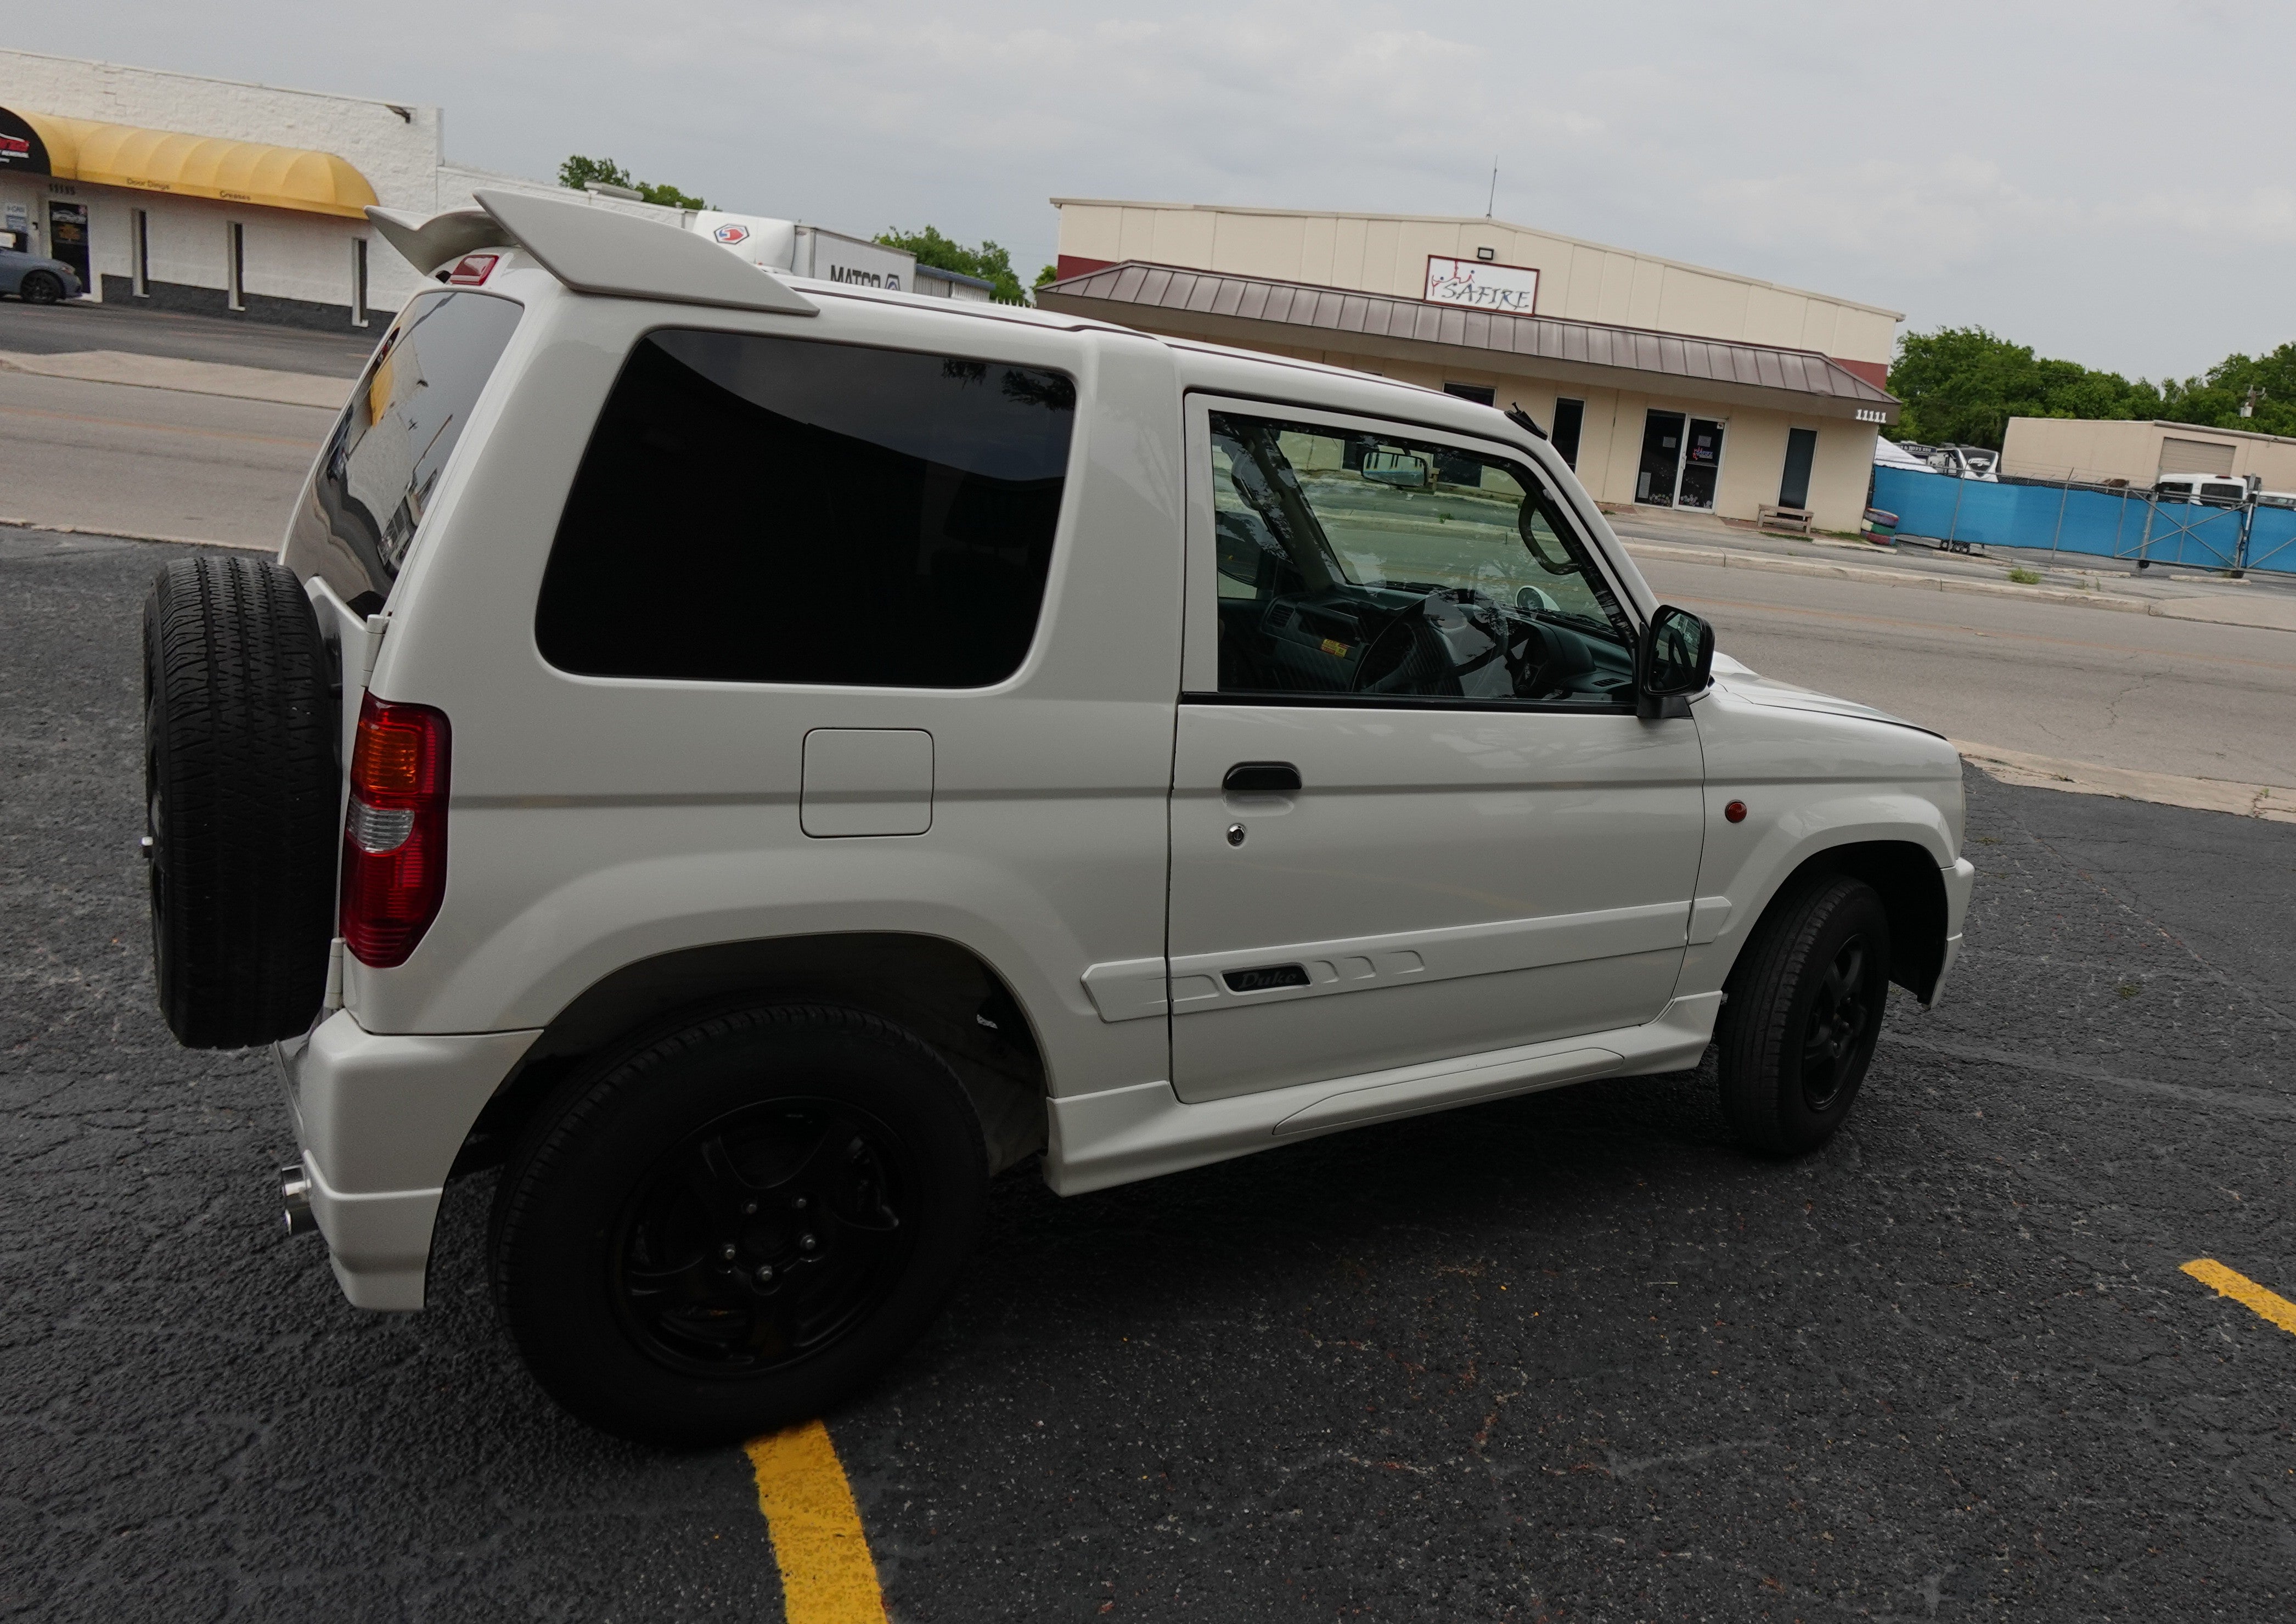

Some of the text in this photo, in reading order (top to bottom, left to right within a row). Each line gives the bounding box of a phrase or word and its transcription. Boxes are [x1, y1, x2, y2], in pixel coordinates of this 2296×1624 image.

[830, 265, 881, 288] MATCO
[1442, 282, 1530, 311] SAFIRE
[1856, 409, 1887, 423] 11111
[1239, 971, 1297, 989] Duke
